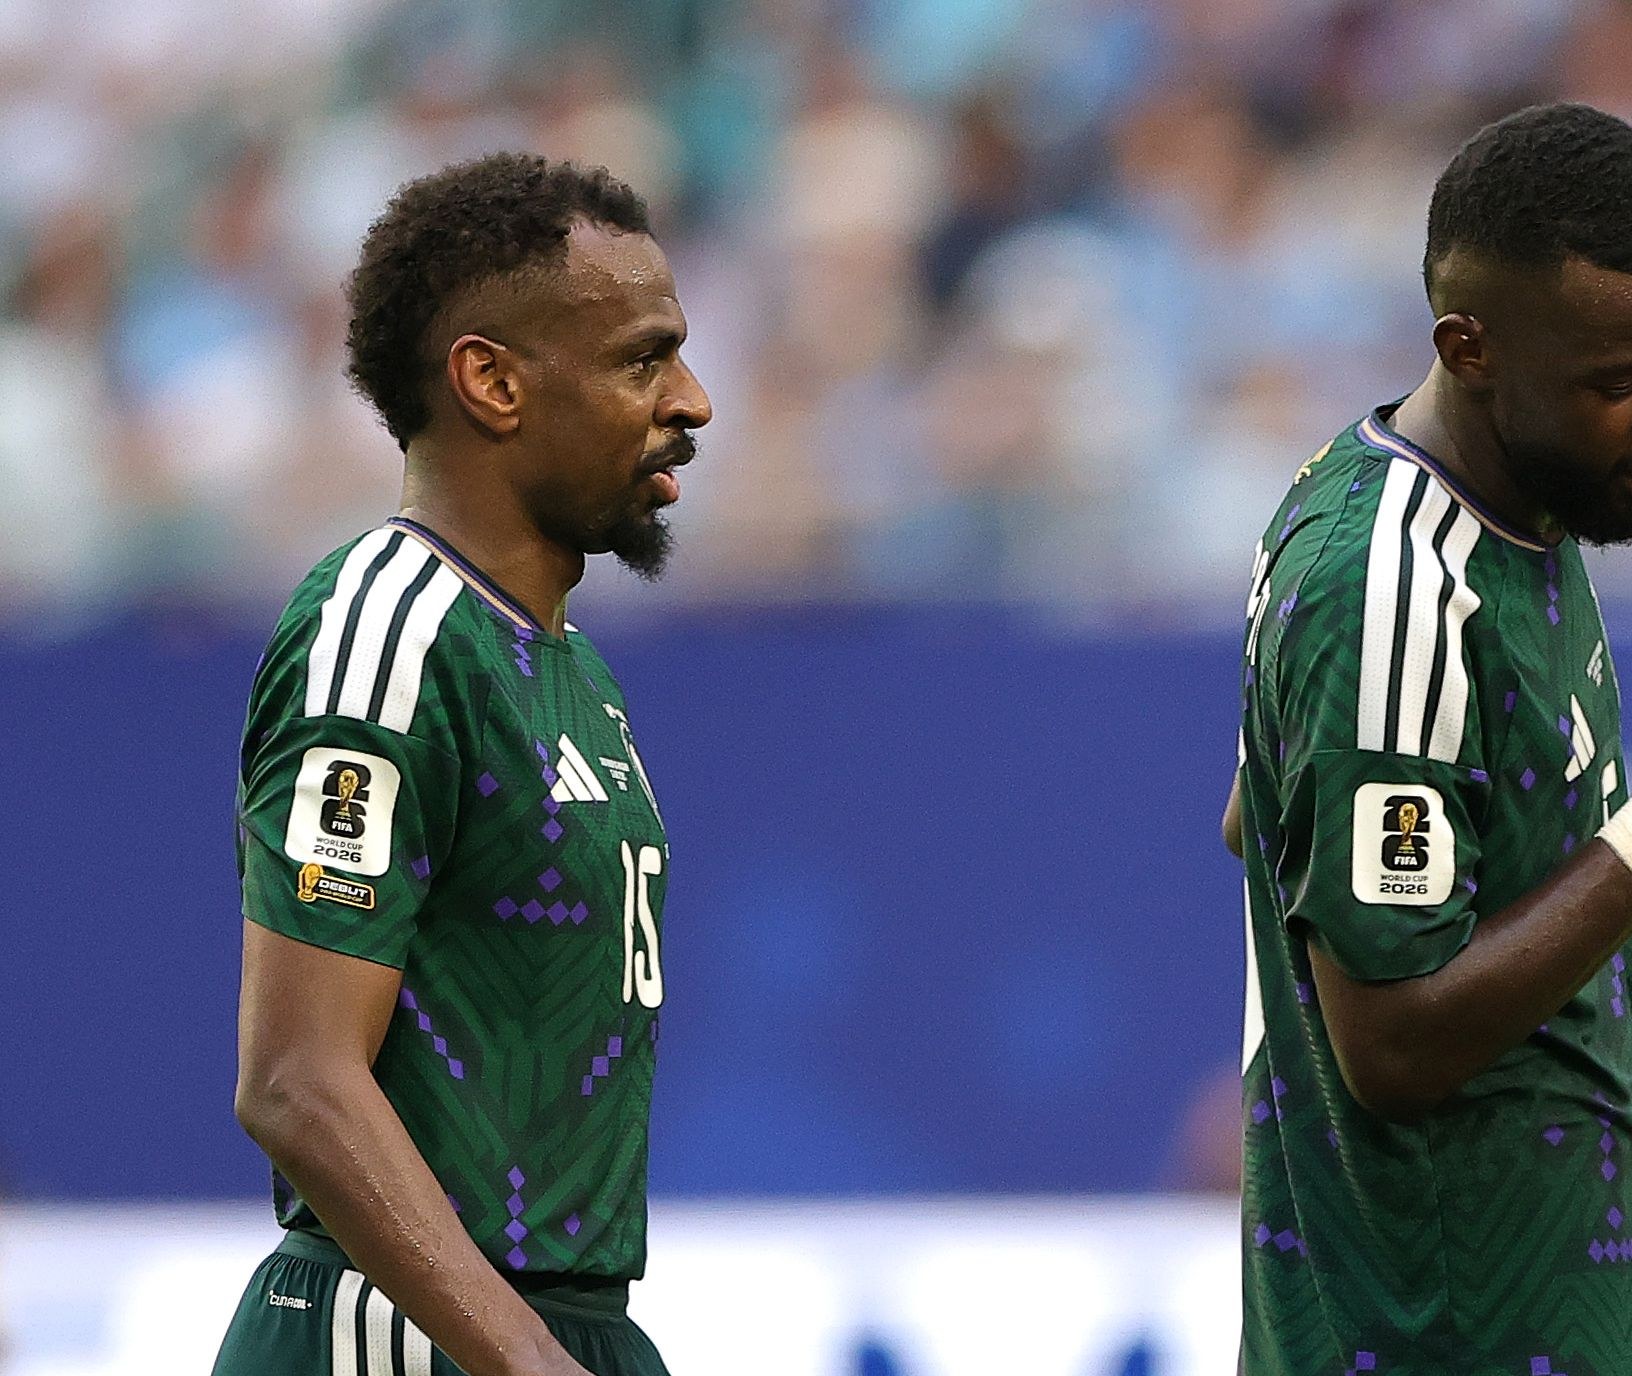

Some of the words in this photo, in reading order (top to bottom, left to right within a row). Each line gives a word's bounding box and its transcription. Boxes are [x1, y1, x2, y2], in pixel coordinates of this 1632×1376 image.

[331, 820, 354, 833] FIFA
[316, 837, 346, 848] WORLD
[346, 842, 364, 851] CUP
[312, 844, 363, 864] 2026
[1394, 855, 1418, 866] FIFA
[1380, 874, 1411, 882] WORLD
[1412, 874, 1429, 883] CUP
[318, 879, 368, 898] DEBUT
[1379, 882, 1429, 895] 2026
[621, 839, 664, 1009] 15
